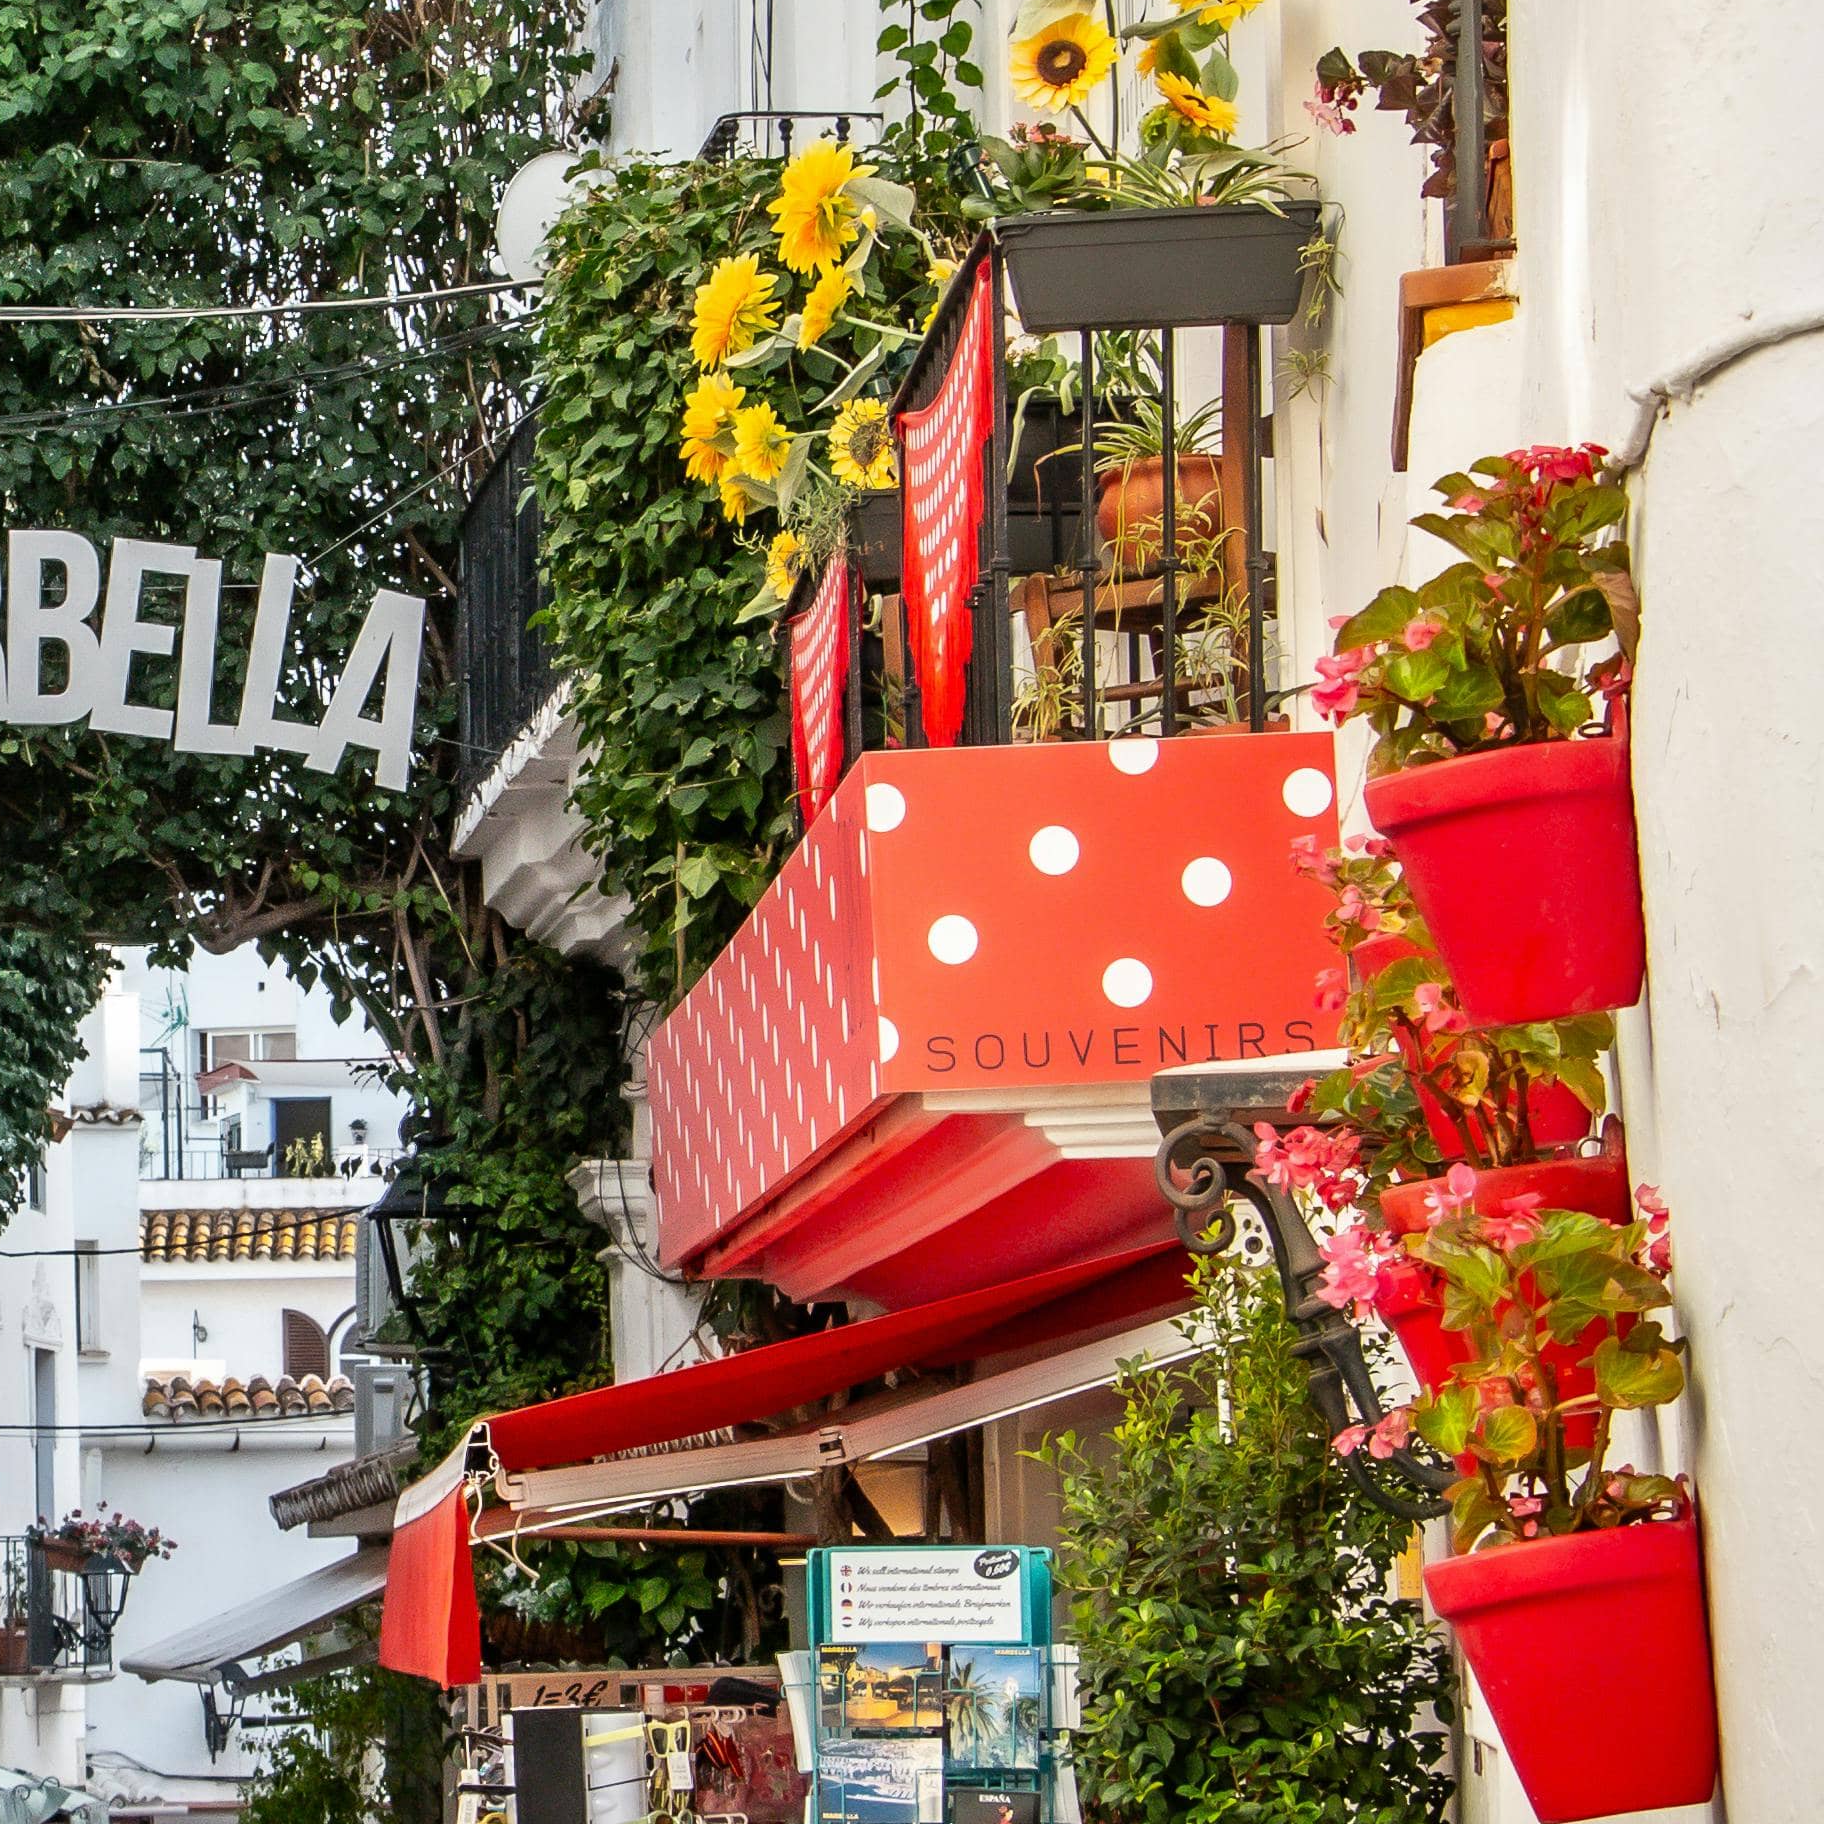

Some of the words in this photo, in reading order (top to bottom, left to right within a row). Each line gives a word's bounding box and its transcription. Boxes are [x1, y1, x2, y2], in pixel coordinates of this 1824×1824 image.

[927, 1020, 1315, 1073] SOUVENIRS
[888, 1565, 934, 1575] international
[857, 1582, 877, 1592] Nous
[878, 1582, 907, 1592] vendons
[950, 1582, 1002, 1591] internationaux
[875, 1600, 912, 1612] verkaufen
[963, 1598, 1011, 1611] Briefmarken
[821, 1646, 858, 1654] MARBELLA
[979, 1794, 1011, 1803] ESPAÑA
